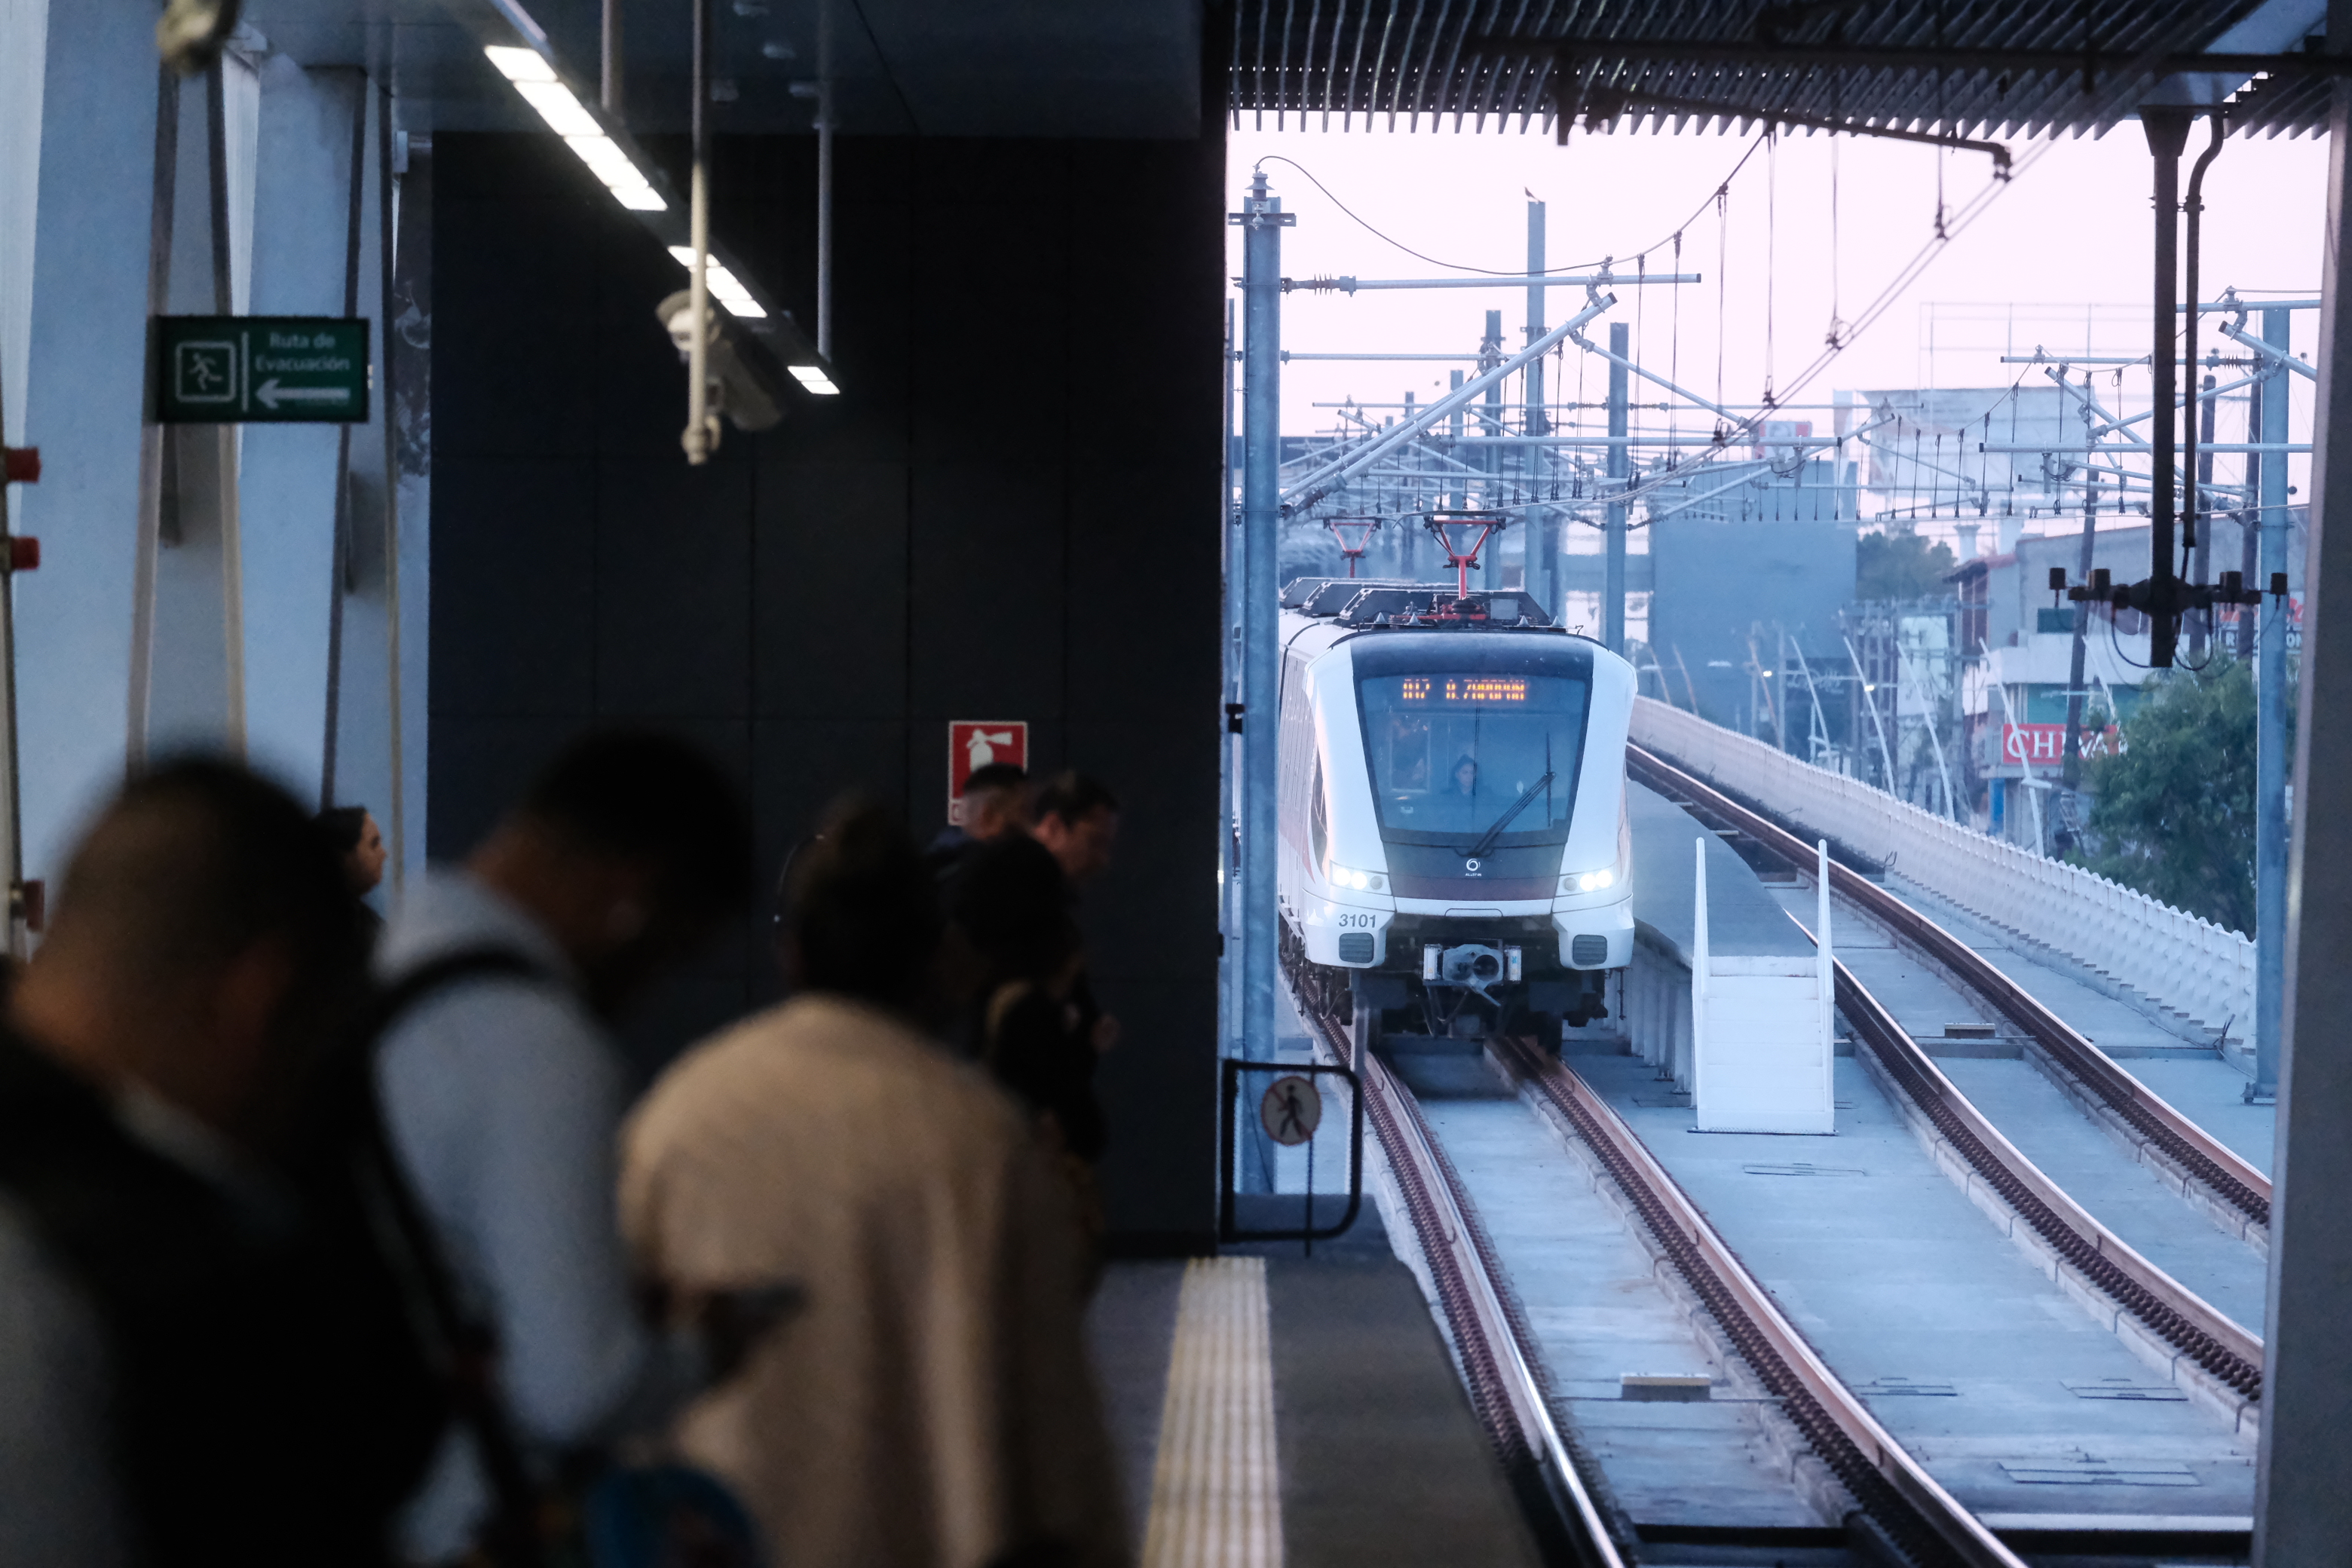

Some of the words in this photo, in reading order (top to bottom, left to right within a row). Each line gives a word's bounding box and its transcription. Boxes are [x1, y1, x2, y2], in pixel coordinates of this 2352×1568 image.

[270, 332, 309, 348] Ruta
[314, 332, 335, 348] de
[1339, 914, 1376, 928] 3101
